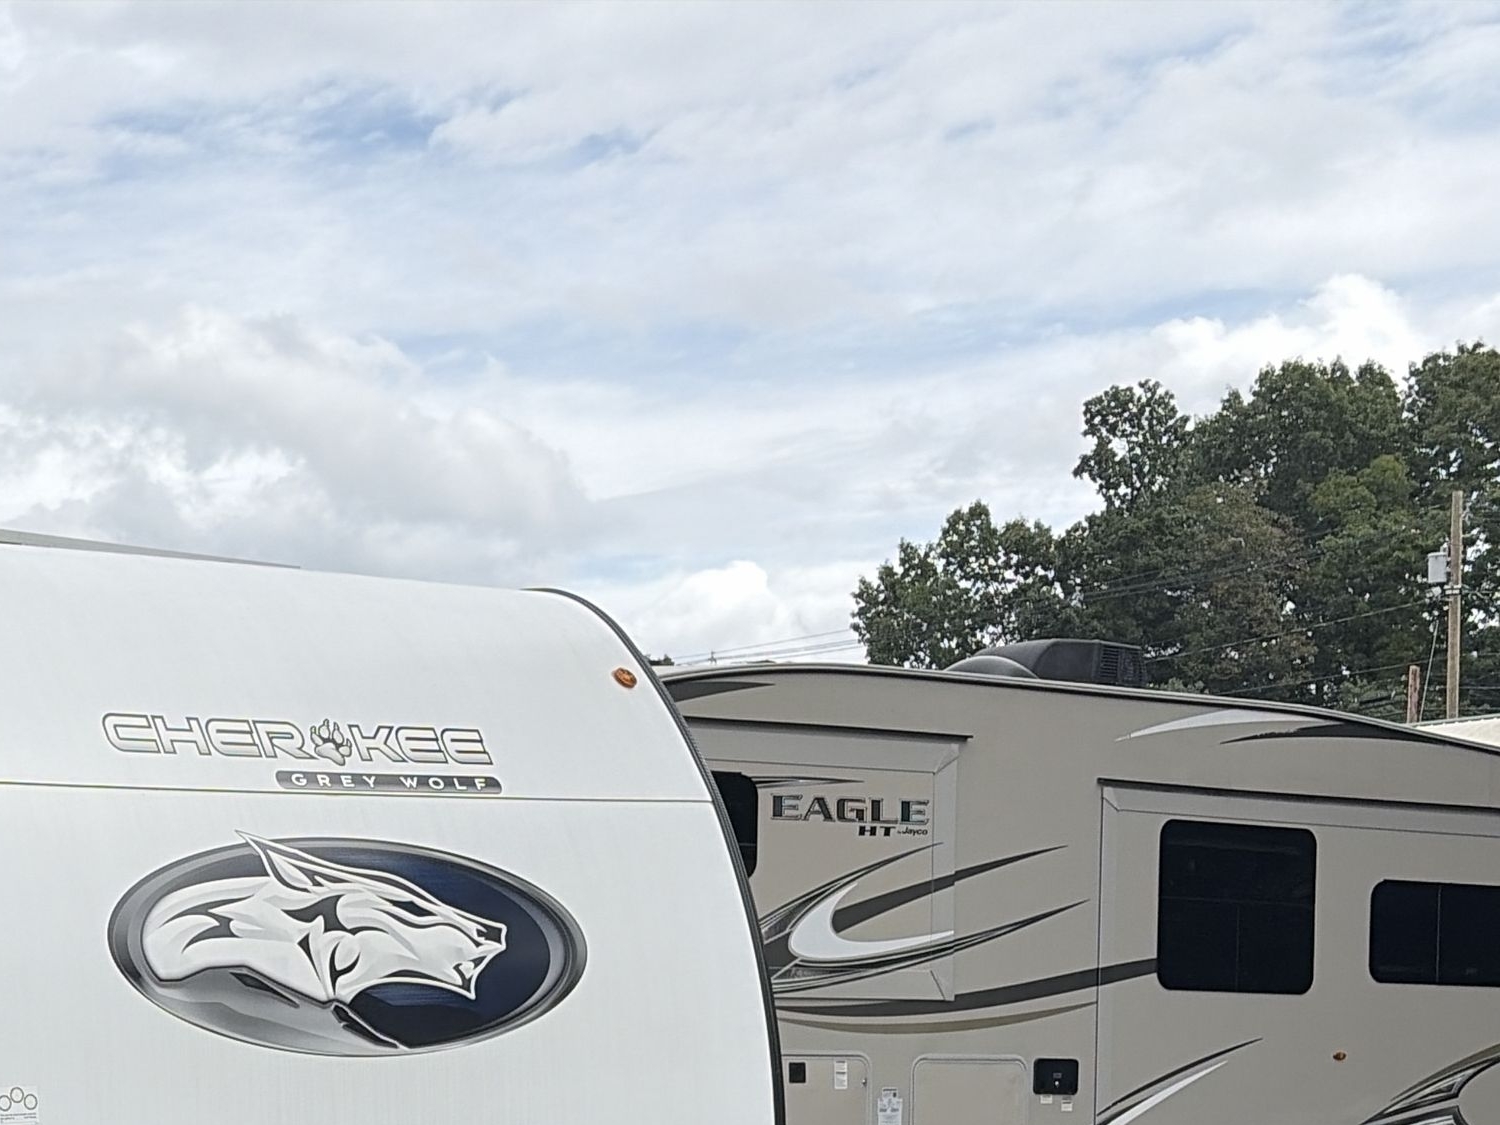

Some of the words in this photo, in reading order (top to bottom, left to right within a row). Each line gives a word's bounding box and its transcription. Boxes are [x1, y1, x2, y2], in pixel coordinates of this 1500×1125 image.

[290, 772, 381, 789] GREY
[399, 776, 489, 791] WOLF
[770, 793, 930, 826] EAGLE
[858, 825, 896, 837] HT
[902, 826, 928, 837] Jayco
